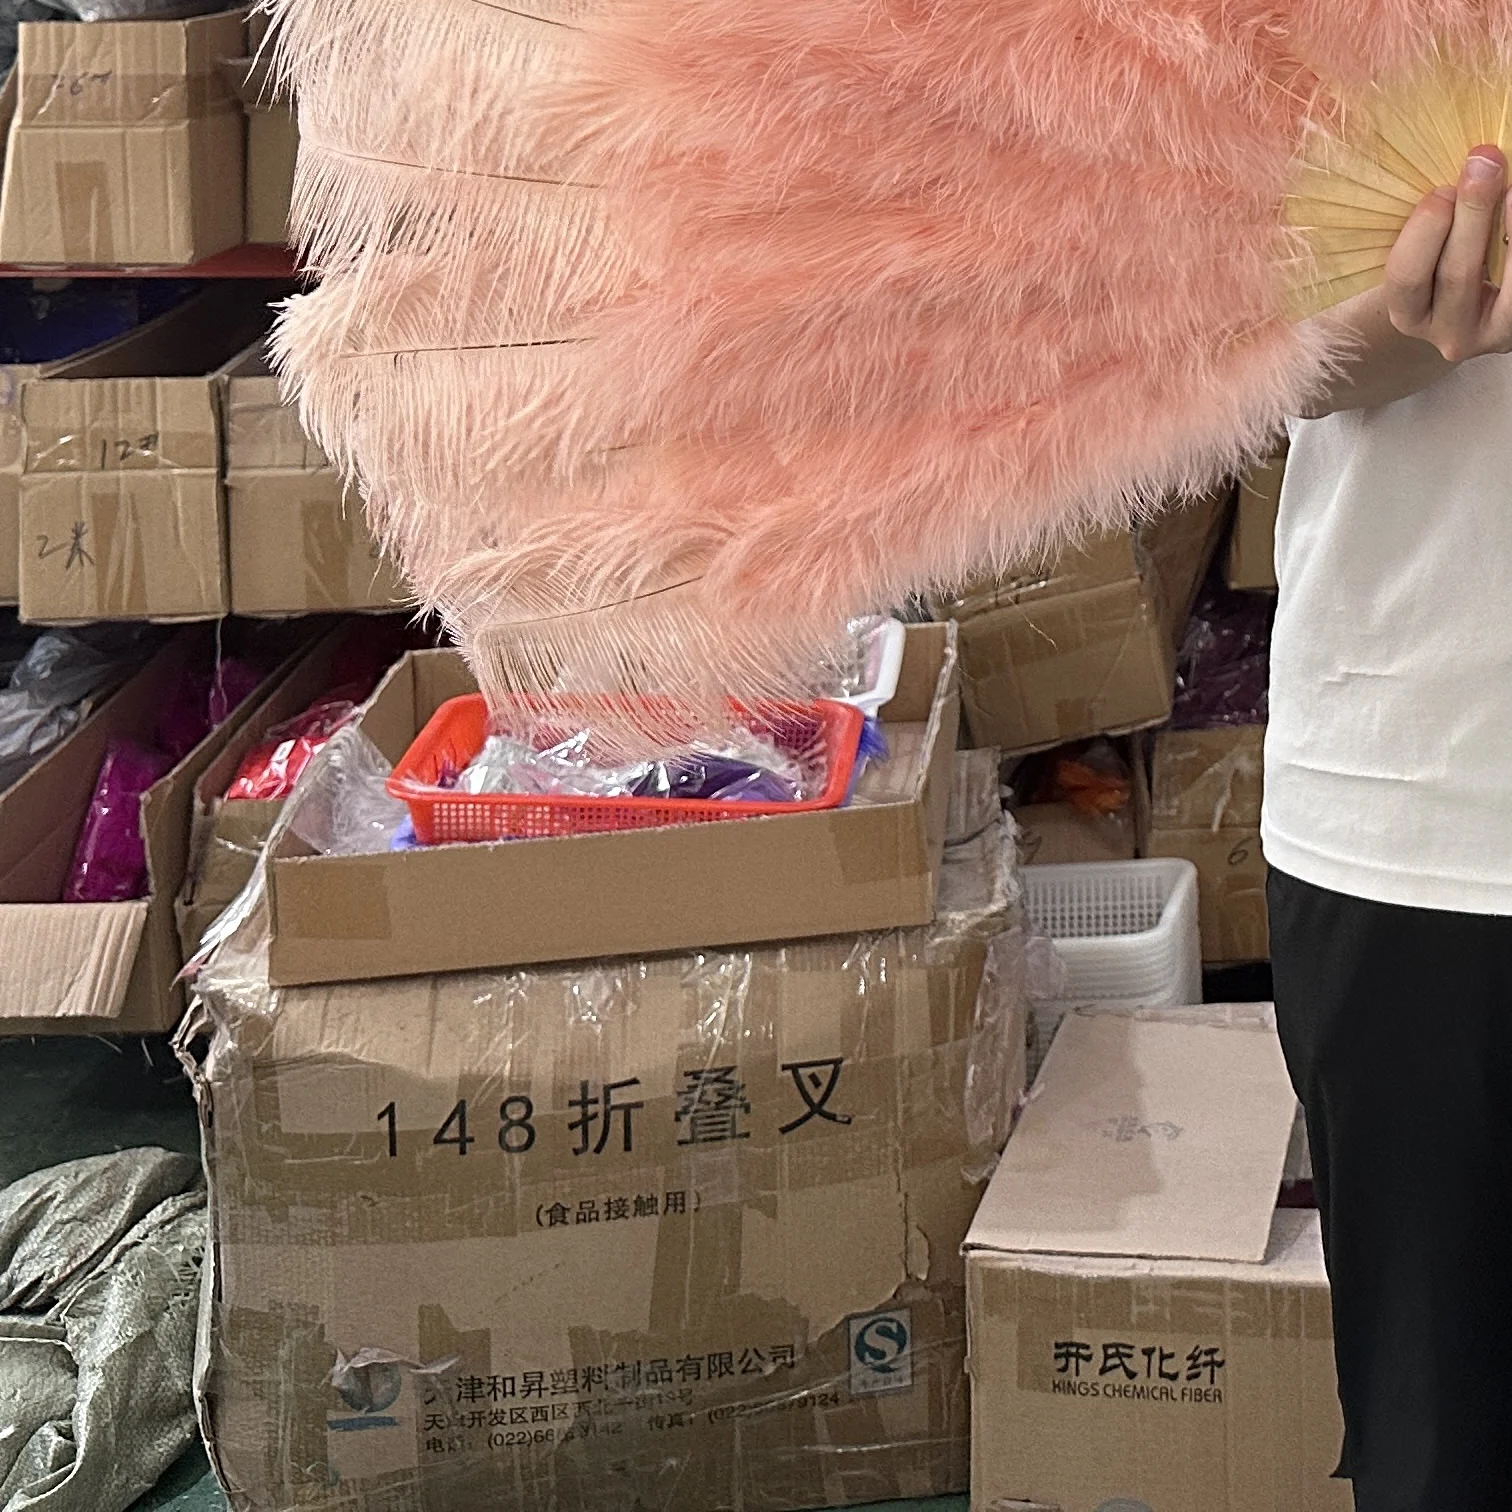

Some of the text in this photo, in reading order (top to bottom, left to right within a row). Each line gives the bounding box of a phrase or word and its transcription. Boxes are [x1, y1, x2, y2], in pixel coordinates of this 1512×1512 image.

[376, 1057, 853, 1157] 148折叠叉
[423, 1343, 796, 1406] 津和昇塑料制品有限公司
[1103, 1383, 1178, 1402] CHEMICAL
[1181, 1387, 1223, 1404] FIBER
